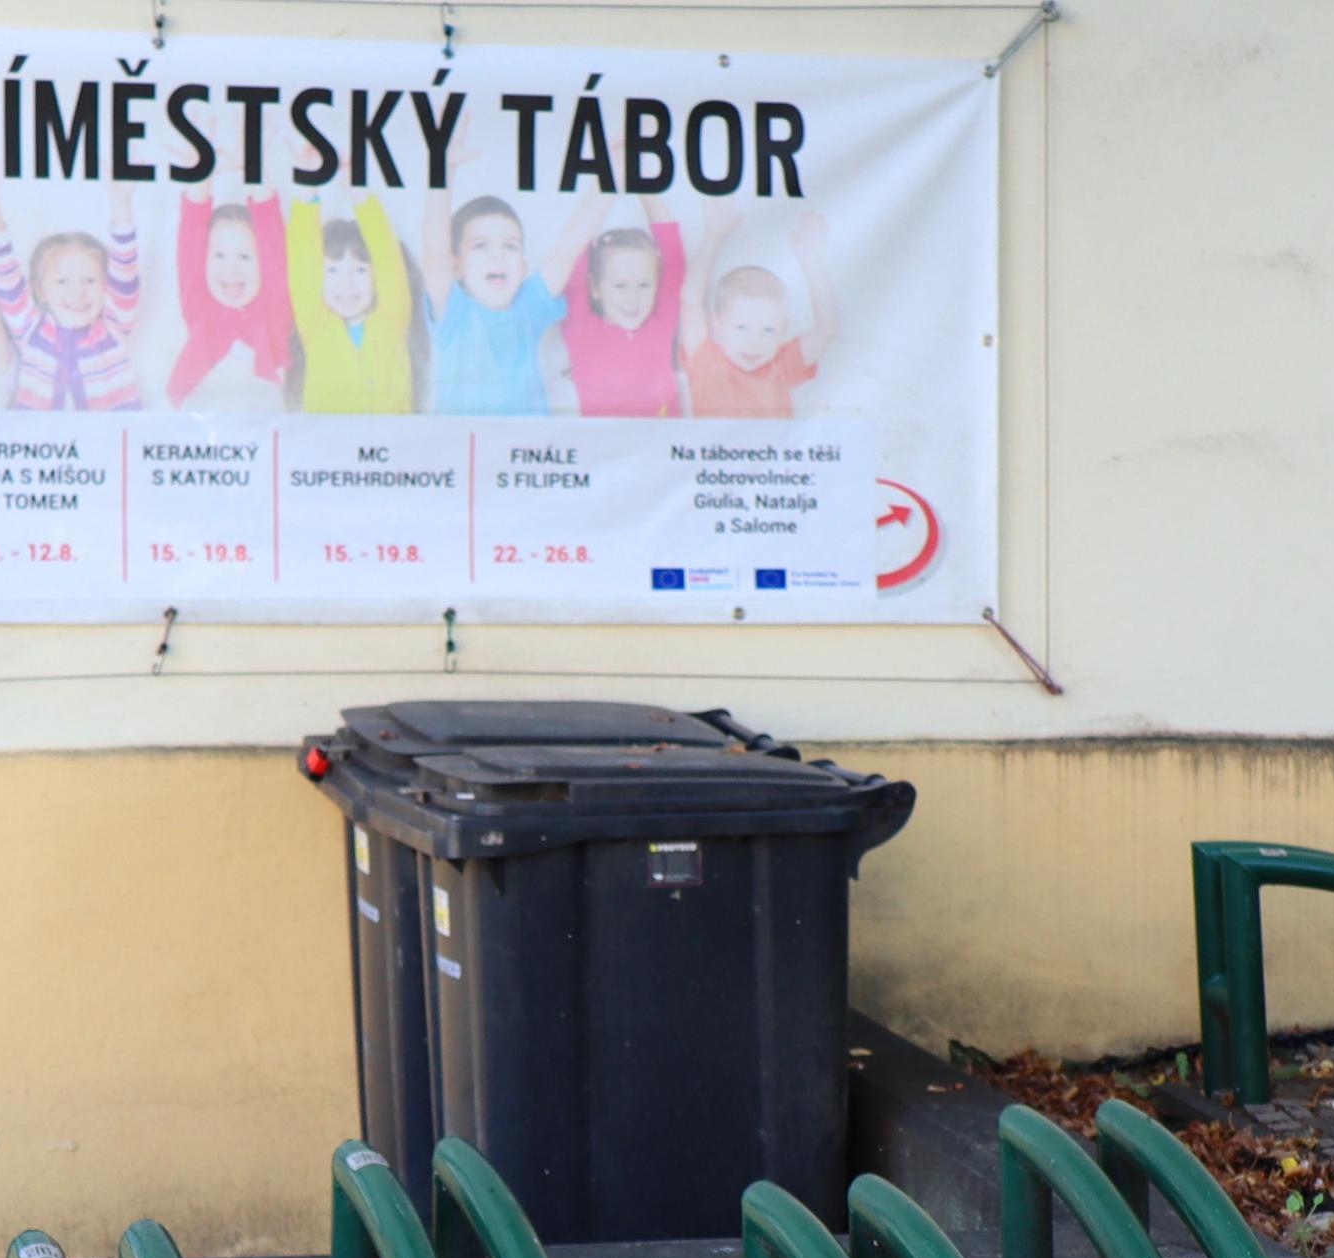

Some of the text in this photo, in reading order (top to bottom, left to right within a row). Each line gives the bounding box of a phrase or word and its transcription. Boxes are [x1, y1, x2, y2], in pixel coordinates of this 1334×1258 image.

[501, 73, 805, 198] TÁBOR
[142, 442, 259, 461] KERAMICKÝ
[358, 447, 389, 463] MC
[510, 446, 577, 465] FINÁLE
[671, 445, 841, 462] Na táborech se těší
[20, 468, 33, 485] S
[38, 464, 106, 485] MÍŠOU
[152, 469, 249, 486] S KATKOU
[290, 468, 455, 488] SUPERHRDINOVÉ
[496, 472, 590, 489] S FILIPEM
[695, 468, 815, 486] dobrovolnice:
[3, 493, 78, 510] TOMEM
[693, 492, 818, 514] Giulia, Natalja
[714, 517, 798, 534] a Salome
[28, 543, 78, 562] 12.8.
[150, 543, 180, 562] 15.
[204, 543, 254, 562] 19.8.
[323, 544, 353, 562] 15.
[376, 544, 425, 562] 19.8.
[493, 544, 523, 563] 22.
[544, 545, 593, 563] 26.8.
